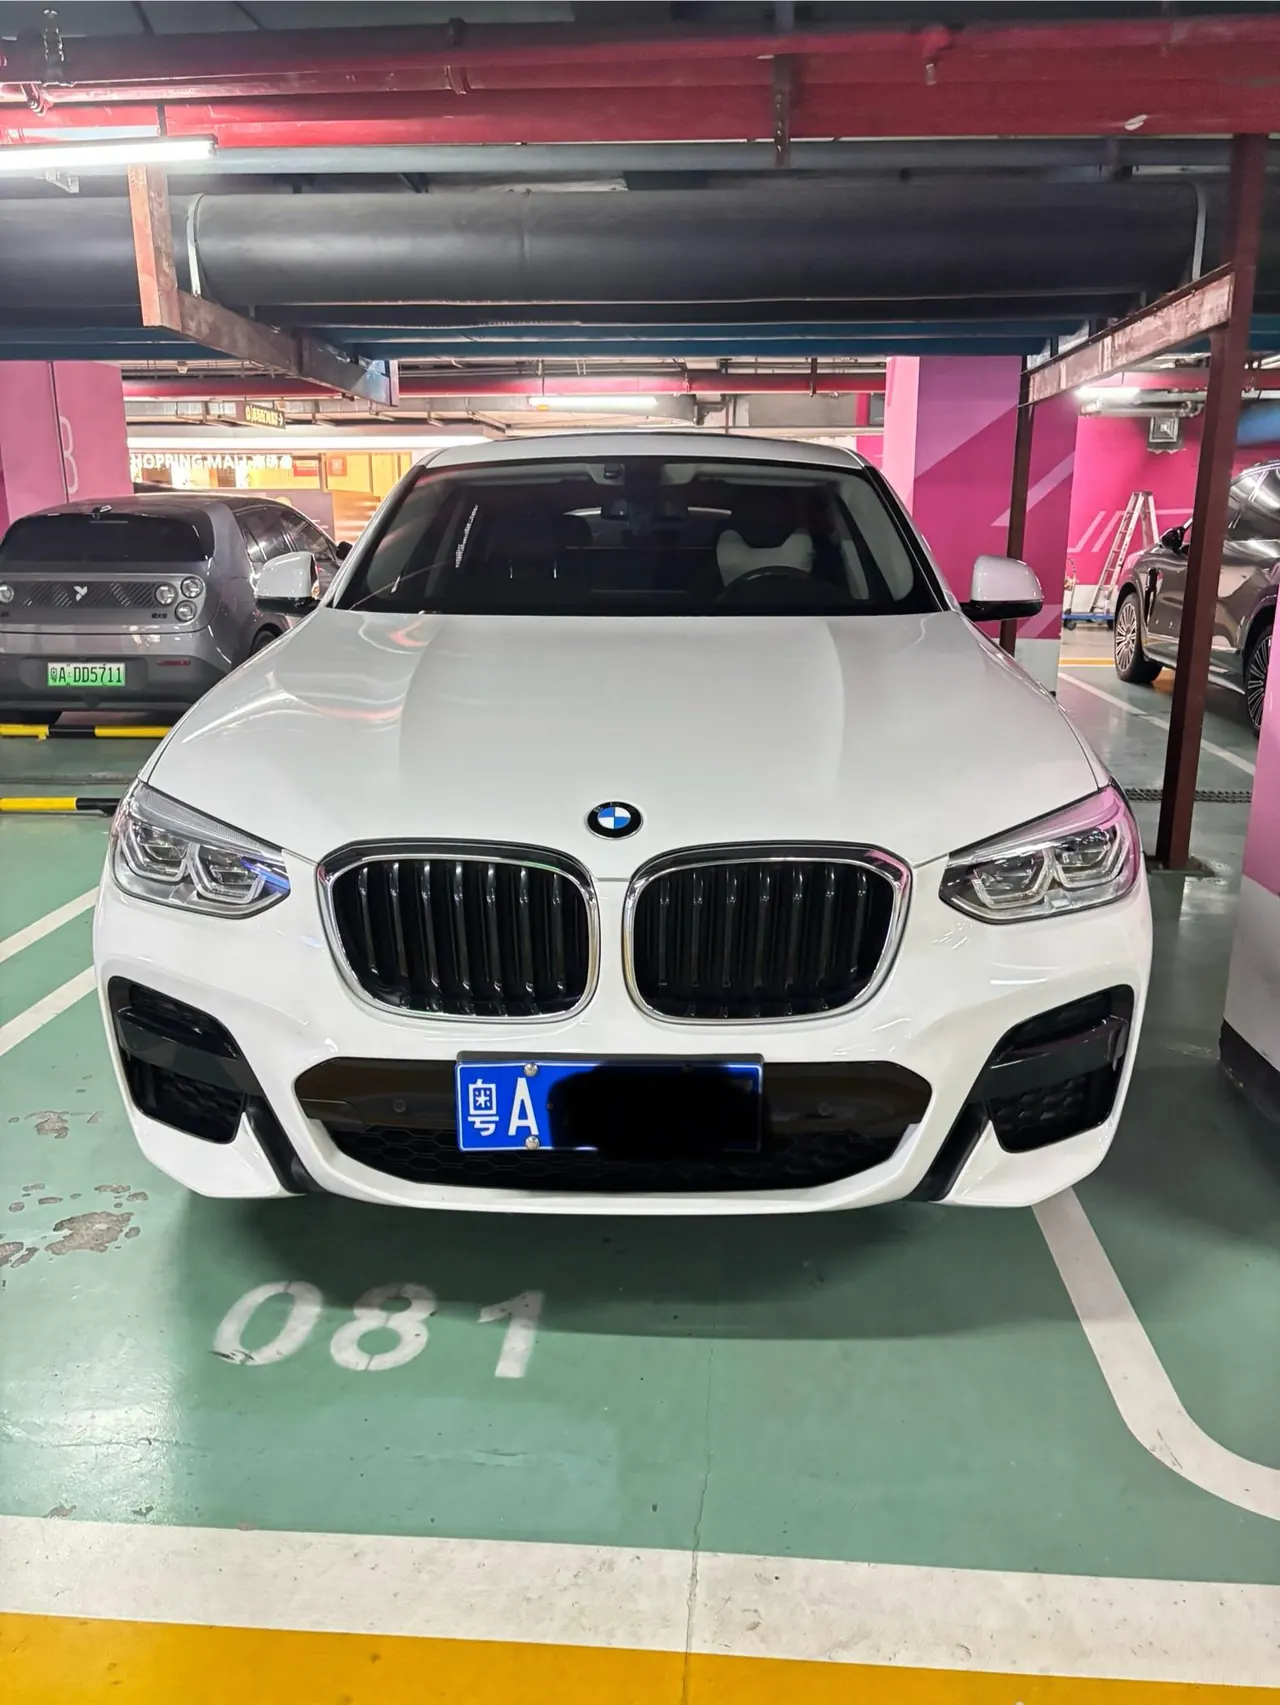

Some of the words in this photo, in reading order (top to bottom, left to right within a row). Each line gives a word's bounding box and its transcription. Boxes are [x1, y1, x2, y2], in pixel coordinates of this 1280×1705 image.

[130, 453, 203, 469] HOPPING
[73, 667, 122, 683] DD5711
[467, 1077, 540, 1137] 粤A
[213, 1280, 546, 1378] 081
